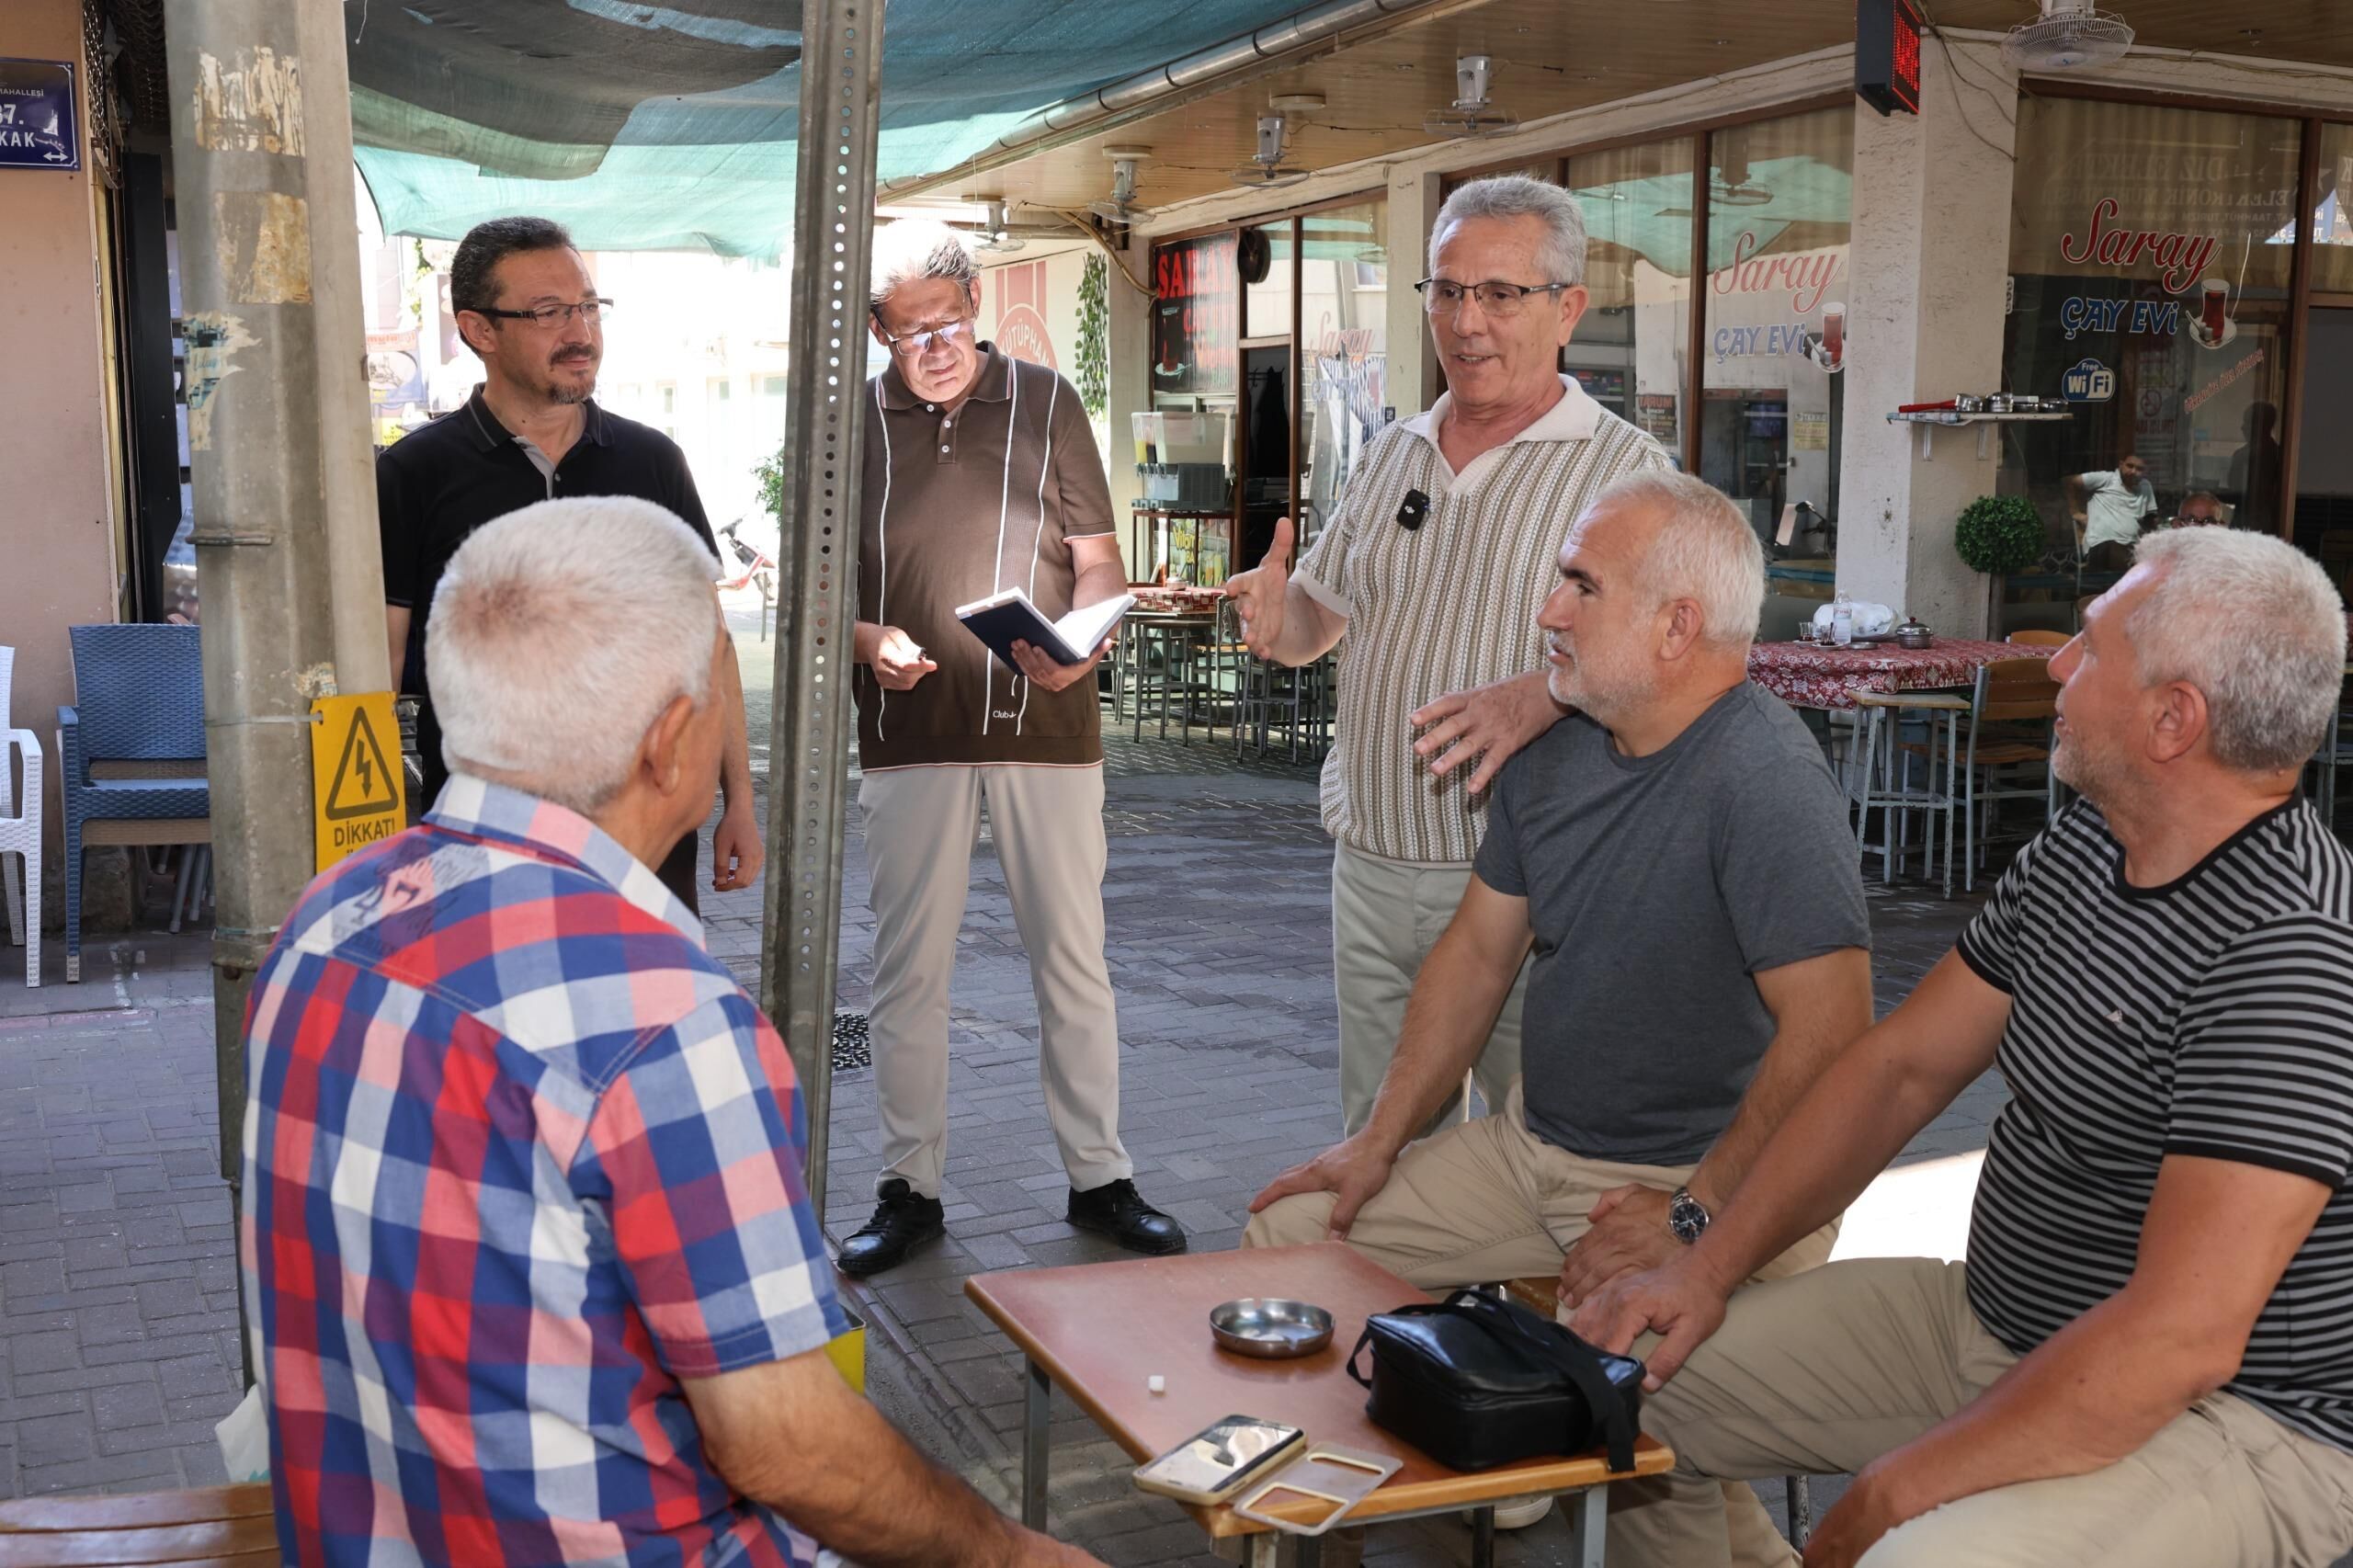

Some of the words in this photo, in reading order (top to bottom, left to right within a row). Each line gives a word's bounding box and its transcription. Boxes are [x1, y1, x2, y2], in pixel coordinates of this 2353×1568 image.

[2061, 198, 2222, 293] Saray
[1712, 232, 1843, 315] Saray
[2061, 296, 2129, 340] ÇAY
[999, 318, 1051, 368] KÜTÜPHAN
[1713, 326, 1764, 366] ÇAY
[2081, 362, 2099, 371] Free
[1173, 526, 1203, 551] Vitamn
[334, 817, 395, 847] DİKKAT!
